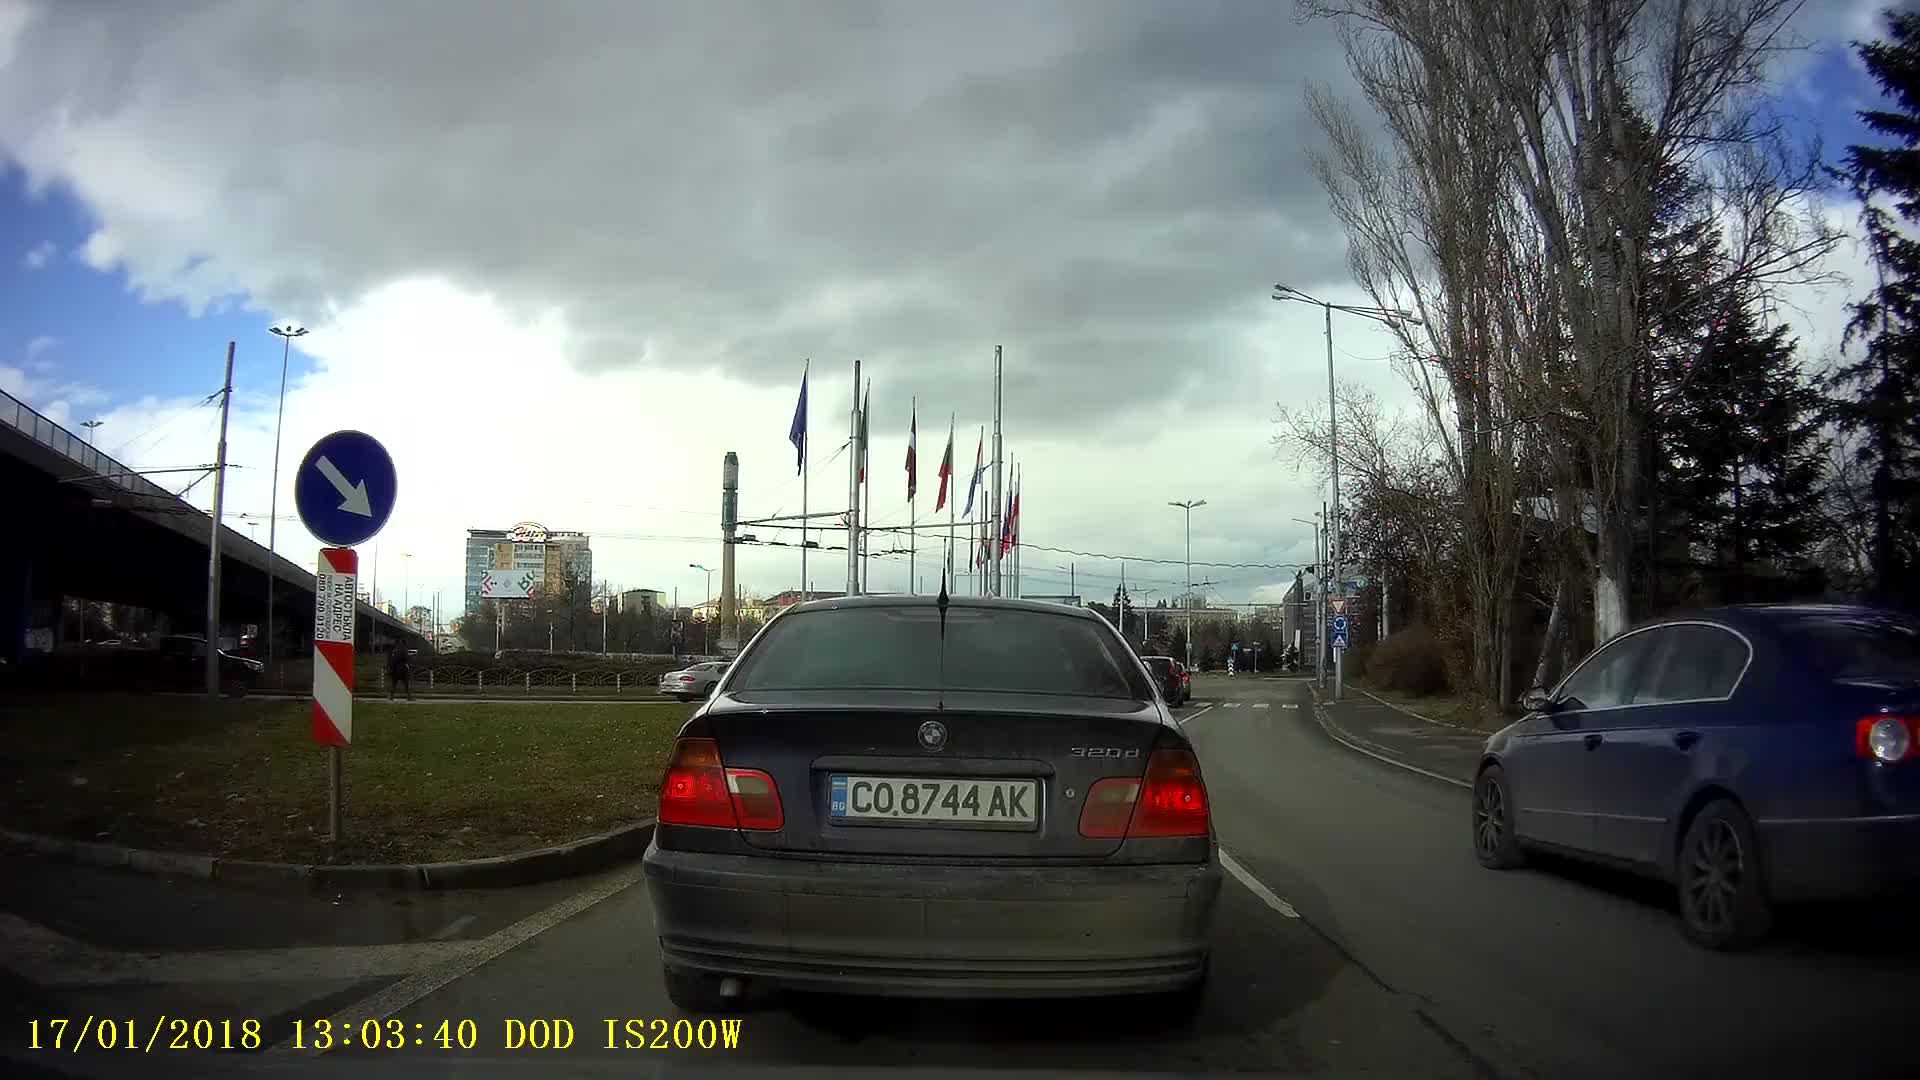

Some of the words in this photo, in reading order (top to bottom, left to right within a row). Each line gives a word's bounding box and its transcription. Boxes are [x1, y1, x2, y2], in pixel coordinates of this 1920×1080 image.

[335, 583, 344, 597] НА
[317, 594, 326, 613] 790
[343, 576, 354, 641] АВТОСТЪКЛА
[332, 599, 343, 632] АДРЕС
[316, 615, 325, 640] 9120
[1071, 747, 1140, 758] 320d
[831, 801, 845, 811] BG
[987, 785, 1029, 818] AK
